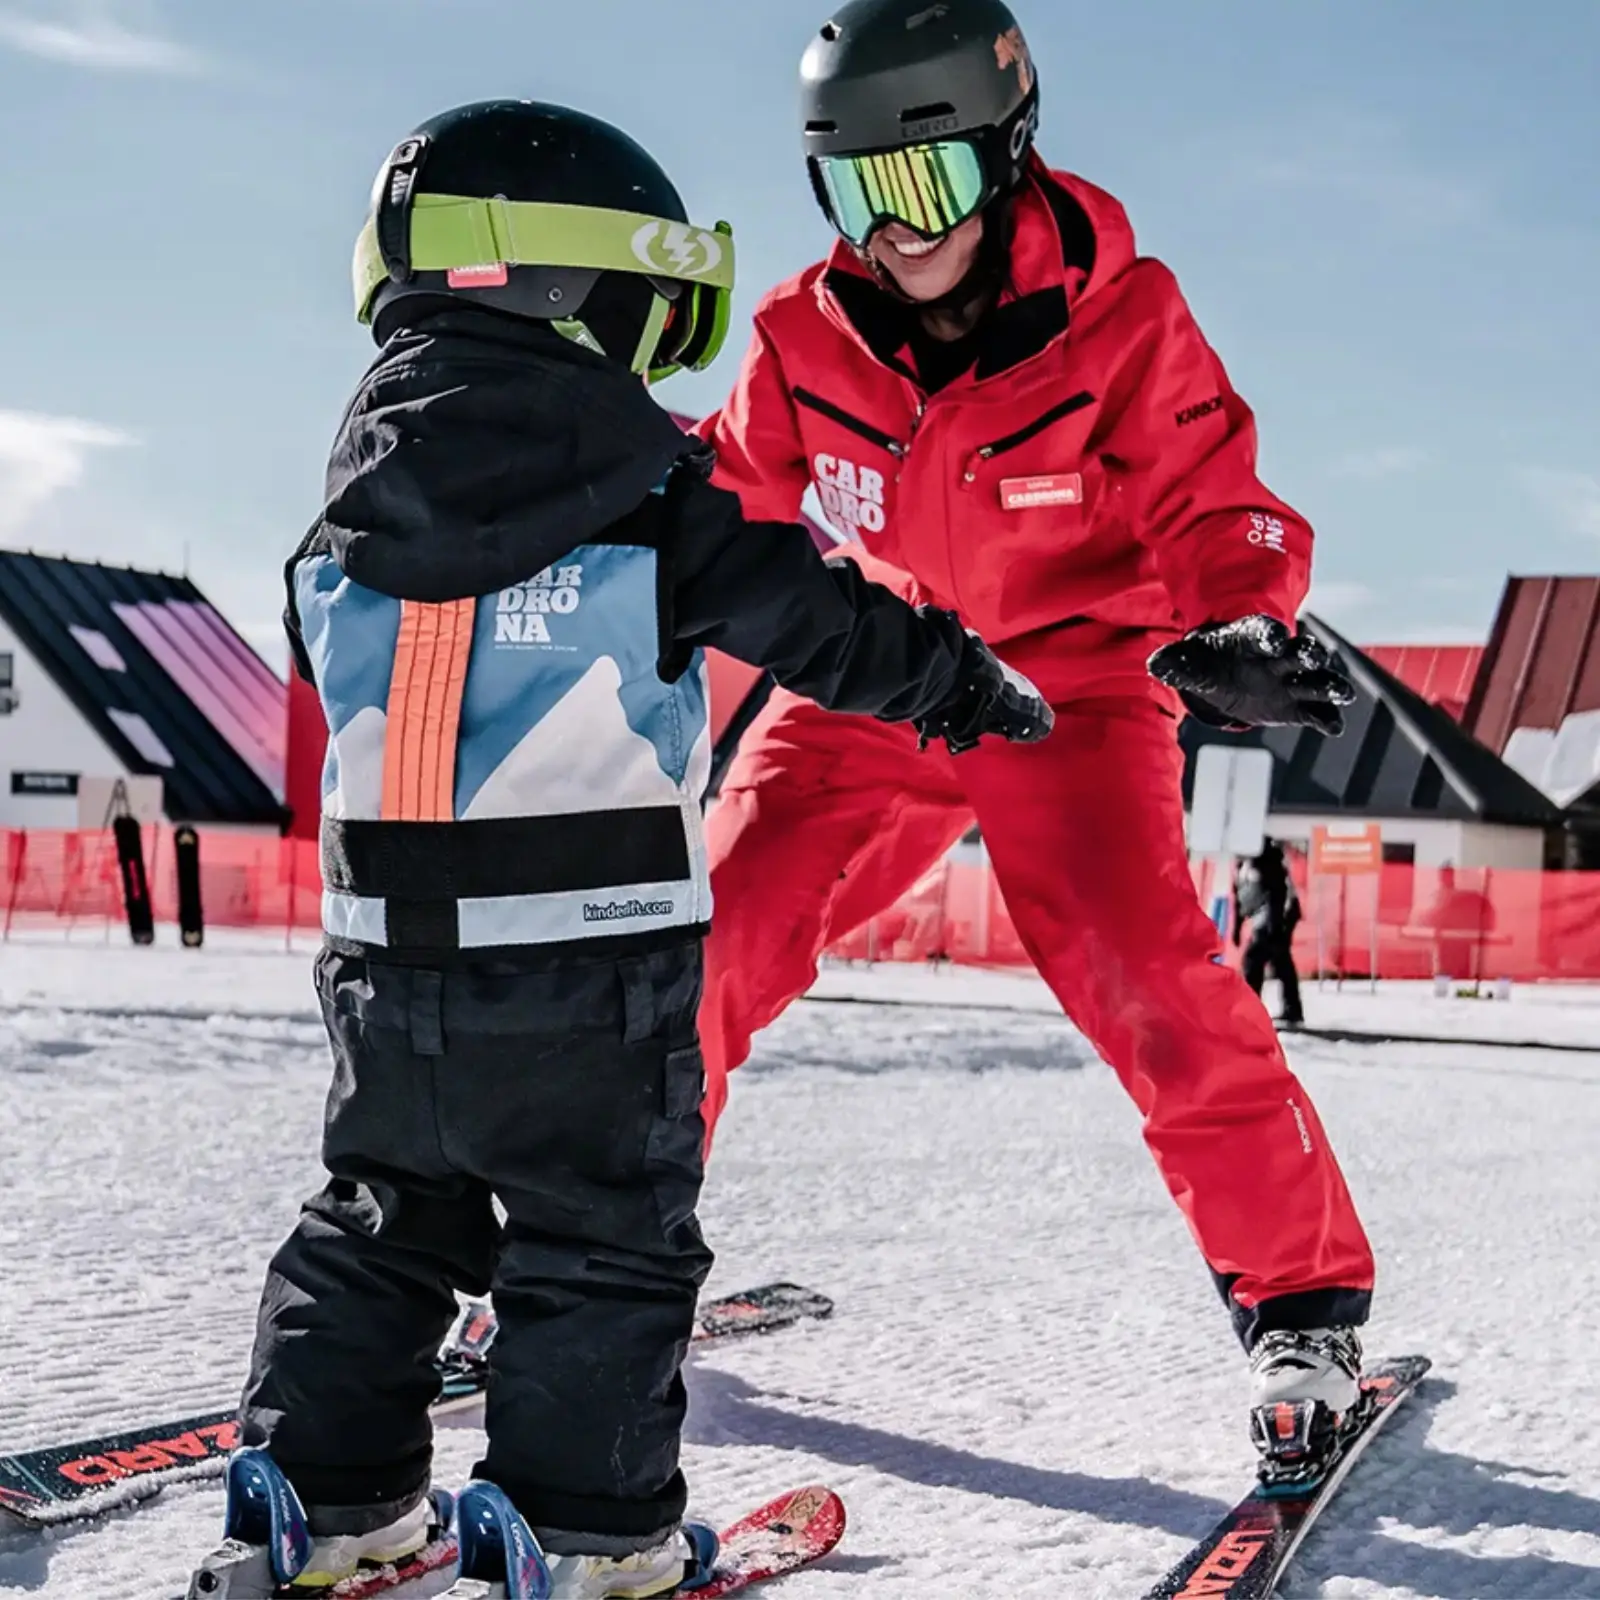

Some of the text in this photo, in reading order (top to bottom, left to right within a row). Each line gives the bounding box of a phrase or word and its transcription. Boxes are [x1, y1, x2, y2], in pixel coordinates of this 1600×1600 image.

[902, 116, 959, 139] GIRO
[814, 452, 884, 506] CAR
[818, 480, 887, 533] DRO
[514, 564, 584, 588] AR
[496, 586, 580, 614] DRO
[494, 613, 551, 643] NA
[583, 899, 675, 921] kinderlift.com
